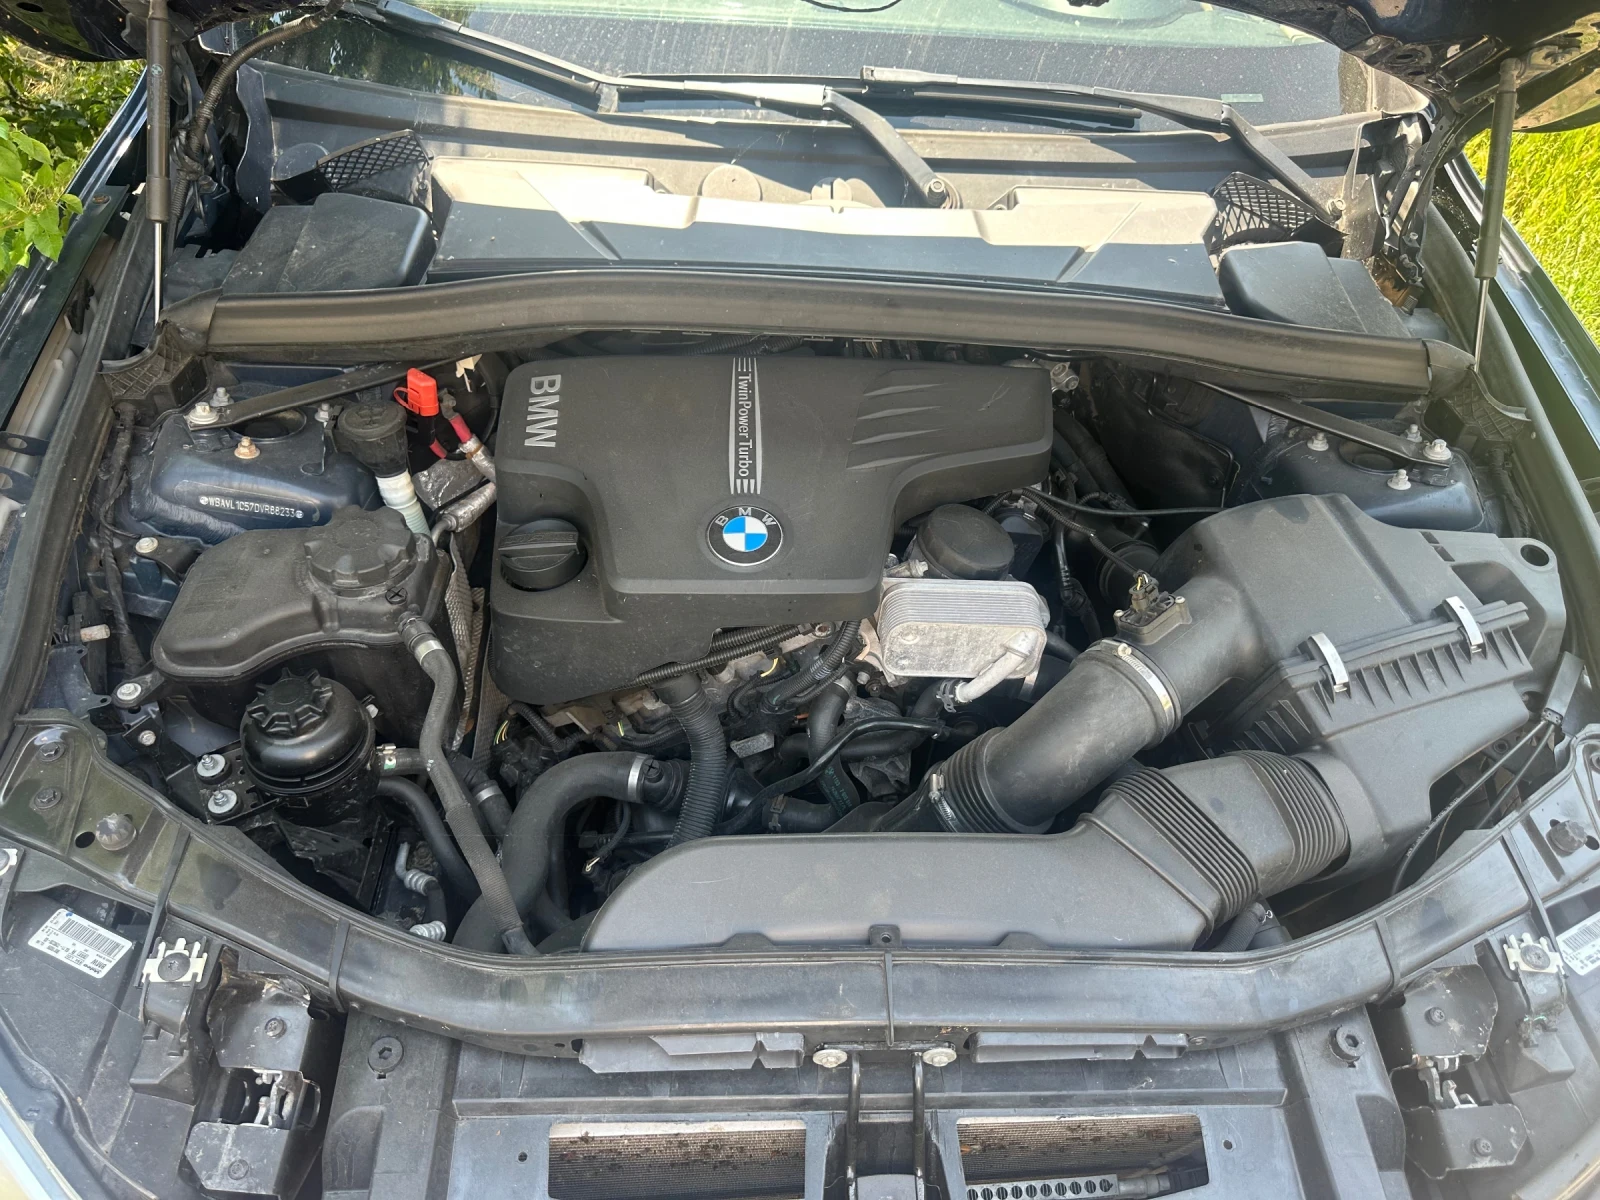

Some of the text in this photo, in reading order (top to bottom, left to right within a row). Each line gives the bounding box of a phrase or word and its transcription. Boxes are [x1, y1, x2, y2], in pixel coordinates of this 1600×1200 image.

[524, 374, 562, 448] BMW
[737, 373, 753, 477] TwinPower Turbo
[715, 506, 777, 528] BMW
